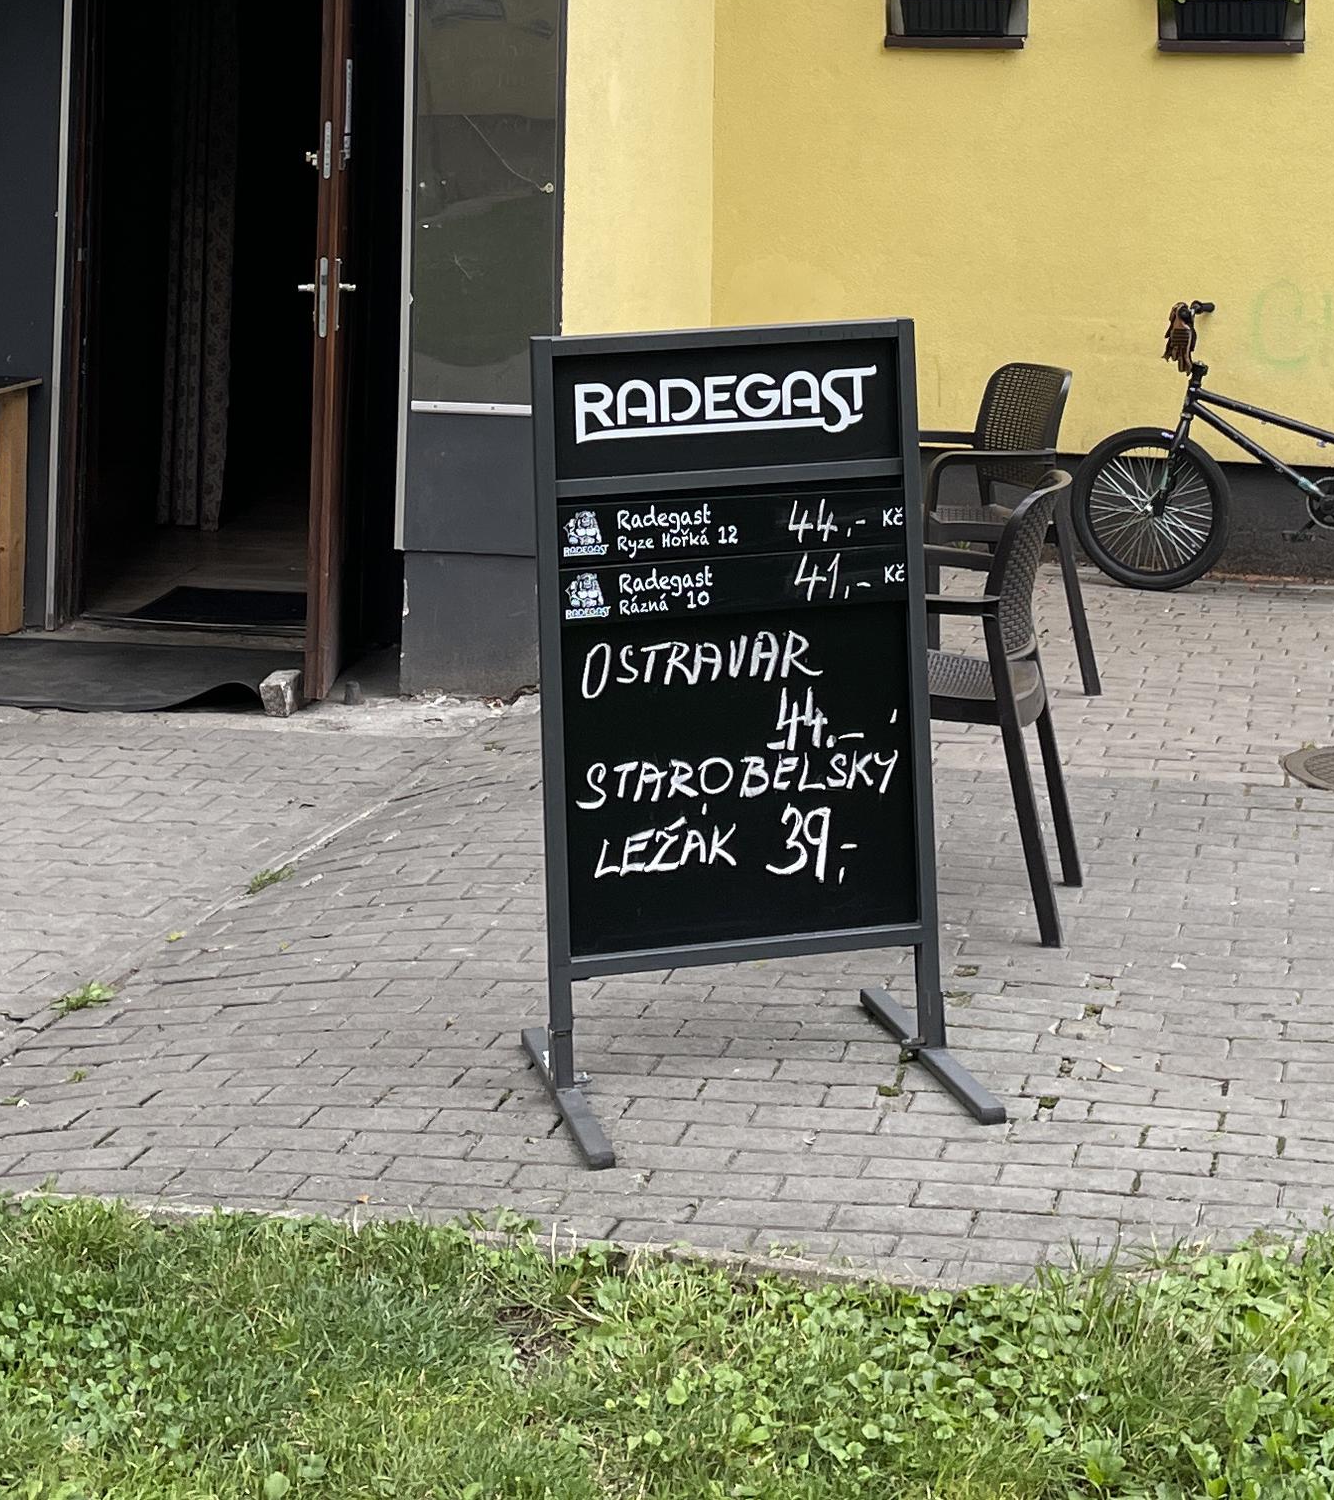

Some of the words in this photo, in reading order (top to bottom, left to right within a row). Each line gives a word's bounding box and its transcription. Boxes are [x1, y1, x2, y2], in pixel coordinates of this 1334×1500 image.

[574, 364, 878, 445] RADEGAST
[617, 503, 712, 534] Radegast
[882, 506, 904, 527] Kč
[617, 536, 655, 559] Ryze
[661, 527, 710, 548] Hořká
[718, 525, 739, 545] 12
[618, 565, 714, 596] Radegast
[884, 563, 905, 584] Kč
[619, 593, 669, 616] Rázná
[686, 591, 710, 609] 10
[582, 629, 823, 699] OSTRAVAR
[593, 802, 738, 879] LEŽÁK
